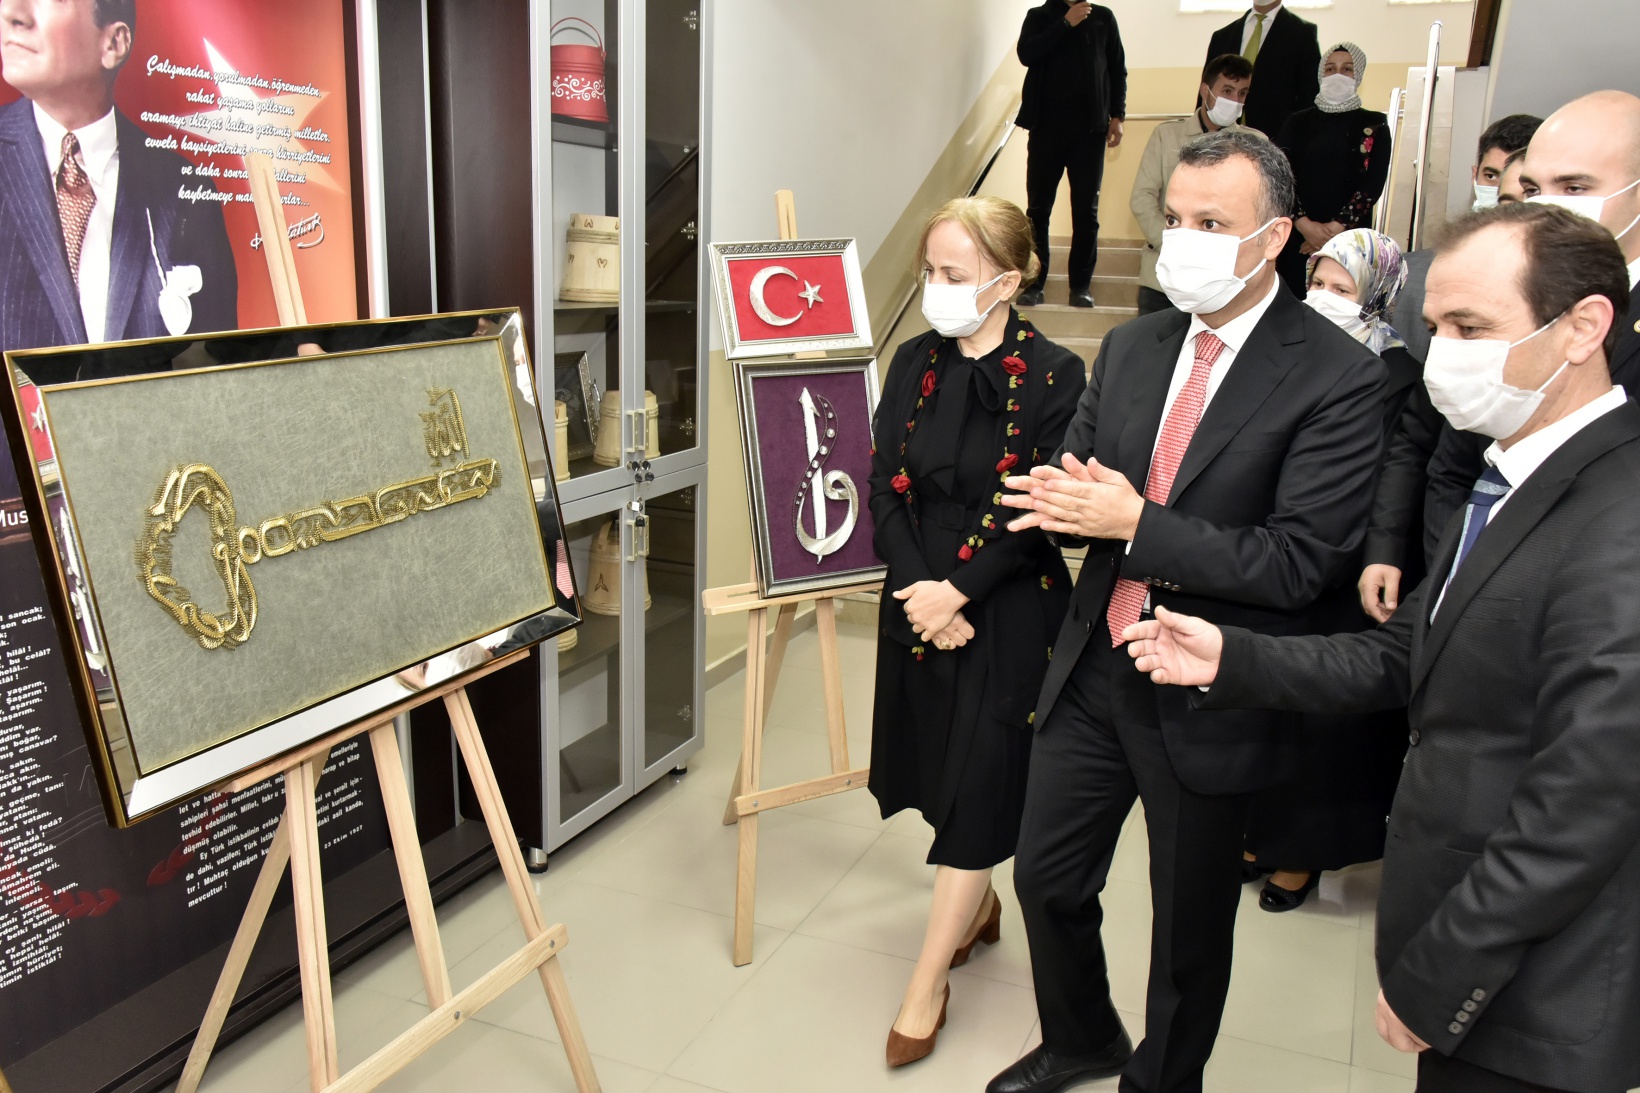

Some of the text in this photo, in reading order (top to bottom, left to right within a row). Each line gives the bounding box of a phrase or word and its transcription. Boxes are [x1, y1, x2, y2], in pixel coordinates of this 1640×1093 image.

[185, 88, 295, 116] rahat yaşama yollarını
[140, 111, 186, 130] aramayı
[188, 112, 223, 134] ihtiyat
[225, 115, 254, 134] haline
[256, 123, 292, 143] getirmiş
[144, 134, 179, 150] evvela
[276, 144, 331, 166] hürriyetlerini
[181, 165, 193, 176] ve
[195, 162, 221, 178] daha
[223, 168, 249, 180] sonra
[178, 184, 234, 206] kaybetmeye
[0, 613, 46, 630] son ocak.
[8, 606, 43, 620] sancak;
[9, 657, 20, 666] bu
[6, 680, 45, 697] yaşarım.
[9, 697, 43, 711] aşarım.
[25, 726, 41, 735] var.
[13, 734, 40, 748] boğar,
[18, 734, 58, 754] canavar?
[9, 757, 36, 770] sakın.
[19, 763, 41, 775] akın.
[338, 759, 346, 768] ve
[11, 785, 22, 793] da
[27, 774, 53, 789] yakın.
[325, 791, 332, 799] ve
[333, 782, 349, 797] şerait
[8, 792, 41, 808] geçme,
[178, 804, 189, 815] let
[191, 800, 201, 810] ve
[180, 808, 209, 828] sahipleri
[231, 779, 273, 805] menfaatlerini,
[22, 811, 52, 825] vatanı.
[181, 826, 202, 842] tevhid
[205, 811, 238, 831] edebilirler.
[240, 799, 260, 814] Millet,
[261, 791, 274, 803] fakr
[332, 808, 343, 821] asil
[345, 799, 364, 814] kanda,
[0, 834, 21, 848] lmaz
[25, 827, 35, 837] ki
[183, 825, 239, 856] düşmüş olabilir.
[199, 851, 208, 862] Ey
[210, 844, 225, 856] Türk
[227, 826, 260, 848] istikbalinin
[333, 833, 348, 845] Ekim
[3, 853, 15, 862] da
[46, 861, 61, 872] eli.
[185, 872, 195, 882] de
[197, 862, 214, 876] dahi,
[216, 849, 241, 867] vazifen;
[243, 840, 258, 852] Türk
[0, 870, 22, 886] ncak
[203, 868, 229, 886] Muhtaç
[232, 853, 258, 871] olduğun
[5, 884, 43, 907] inlemeli.
[6, 912, 60, 942] belki başım.
[5, 944, 16, 956] ey
[21, 932, 43, 948] şanlı
[10, 942, 34, 961] hepsi
